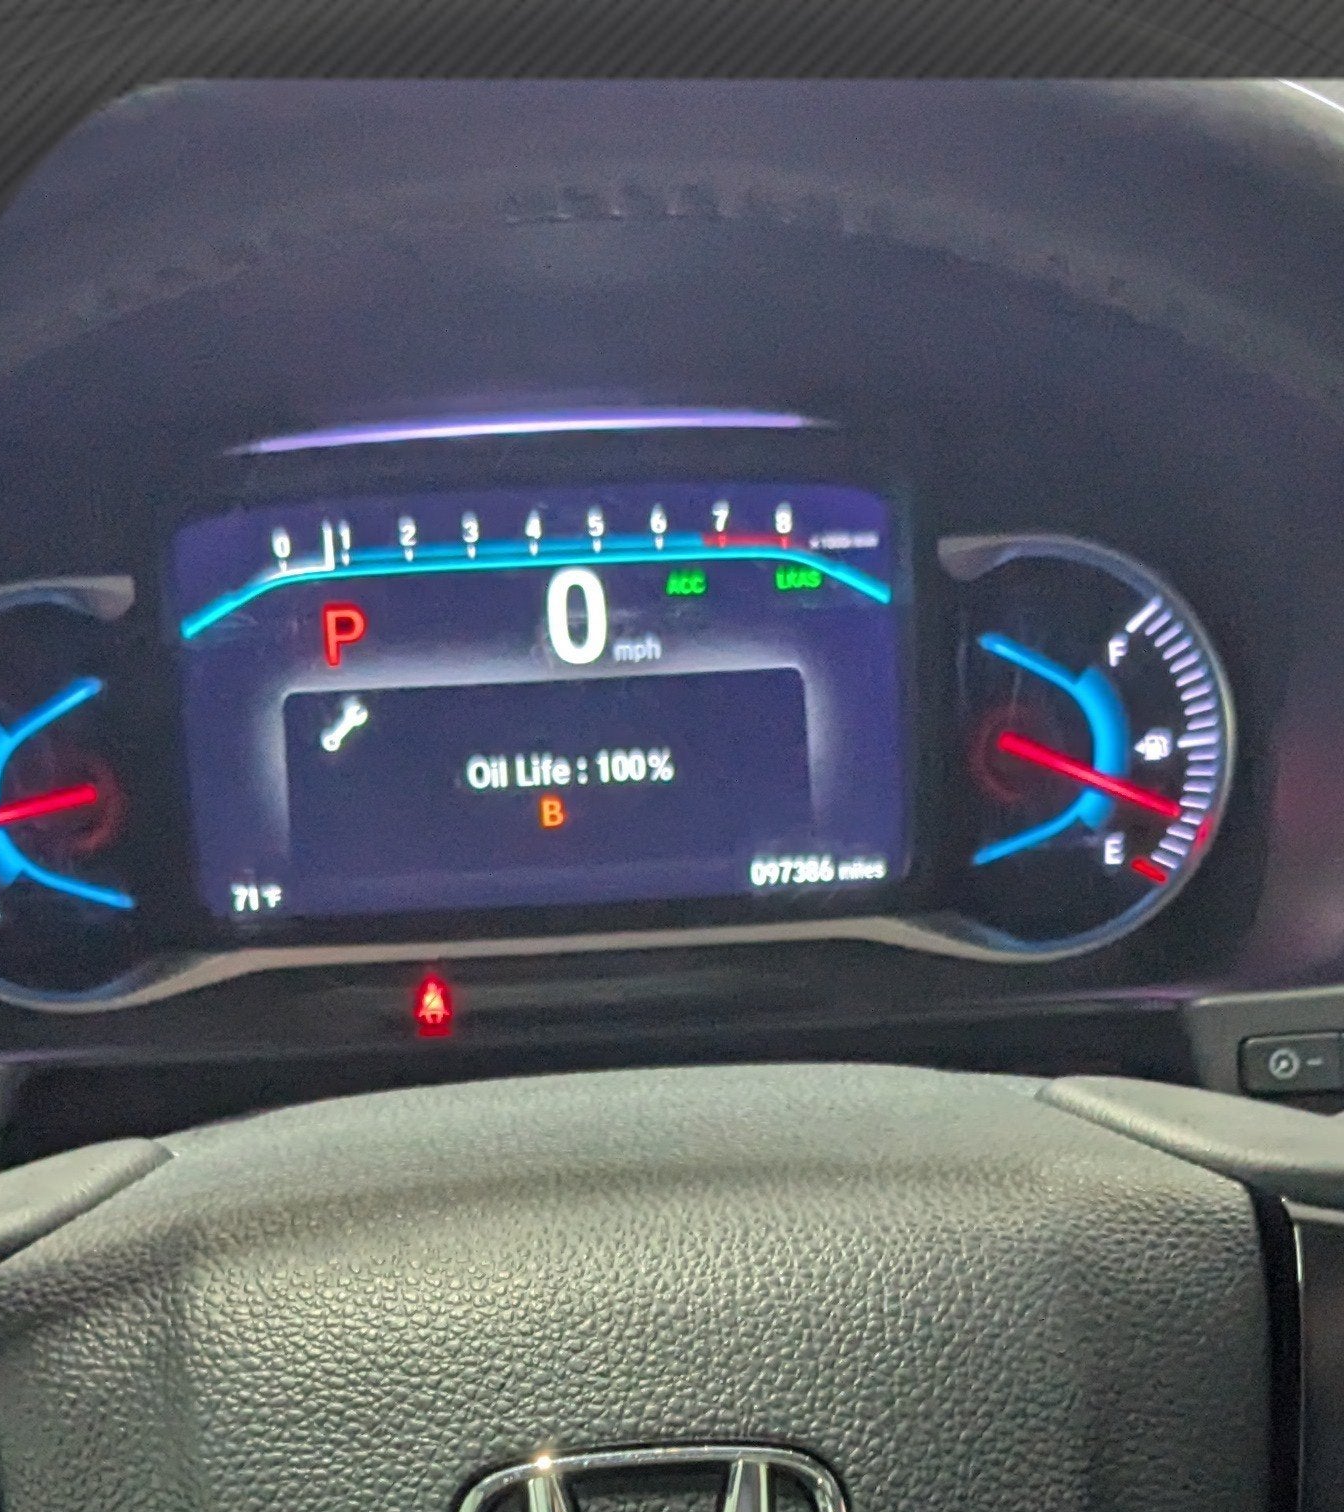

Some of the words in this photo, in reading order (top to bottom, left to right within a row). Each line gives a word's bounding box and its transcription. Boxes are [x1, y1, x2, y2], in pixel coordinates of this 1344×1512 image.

[399, 518, 417, 547] 2
[462, 512, 479, 543] 3
[526, 511, 542, 540] 4
[587, 506, 604, 537] 5
[651, 504, 667, 534] 6
[712, 501, 730, 532] 7
[775, 503, 793, 534] 8
[547, 567, 607, 664] 0
[613, 633, 662, 663] mph
[323, 602, 367, 667] P
[1108, 636, 1127, 667] F
[466, 754, 509, 789] Oil
[514, 752, 572, 787] Life
[596, 748, 675, 784] 100%
[539, 796, 565, 829] B
[1103, 832, 1125, 866] E
[750, 855, 835, 886] 097386
[837, 856, 887, 881] miles
